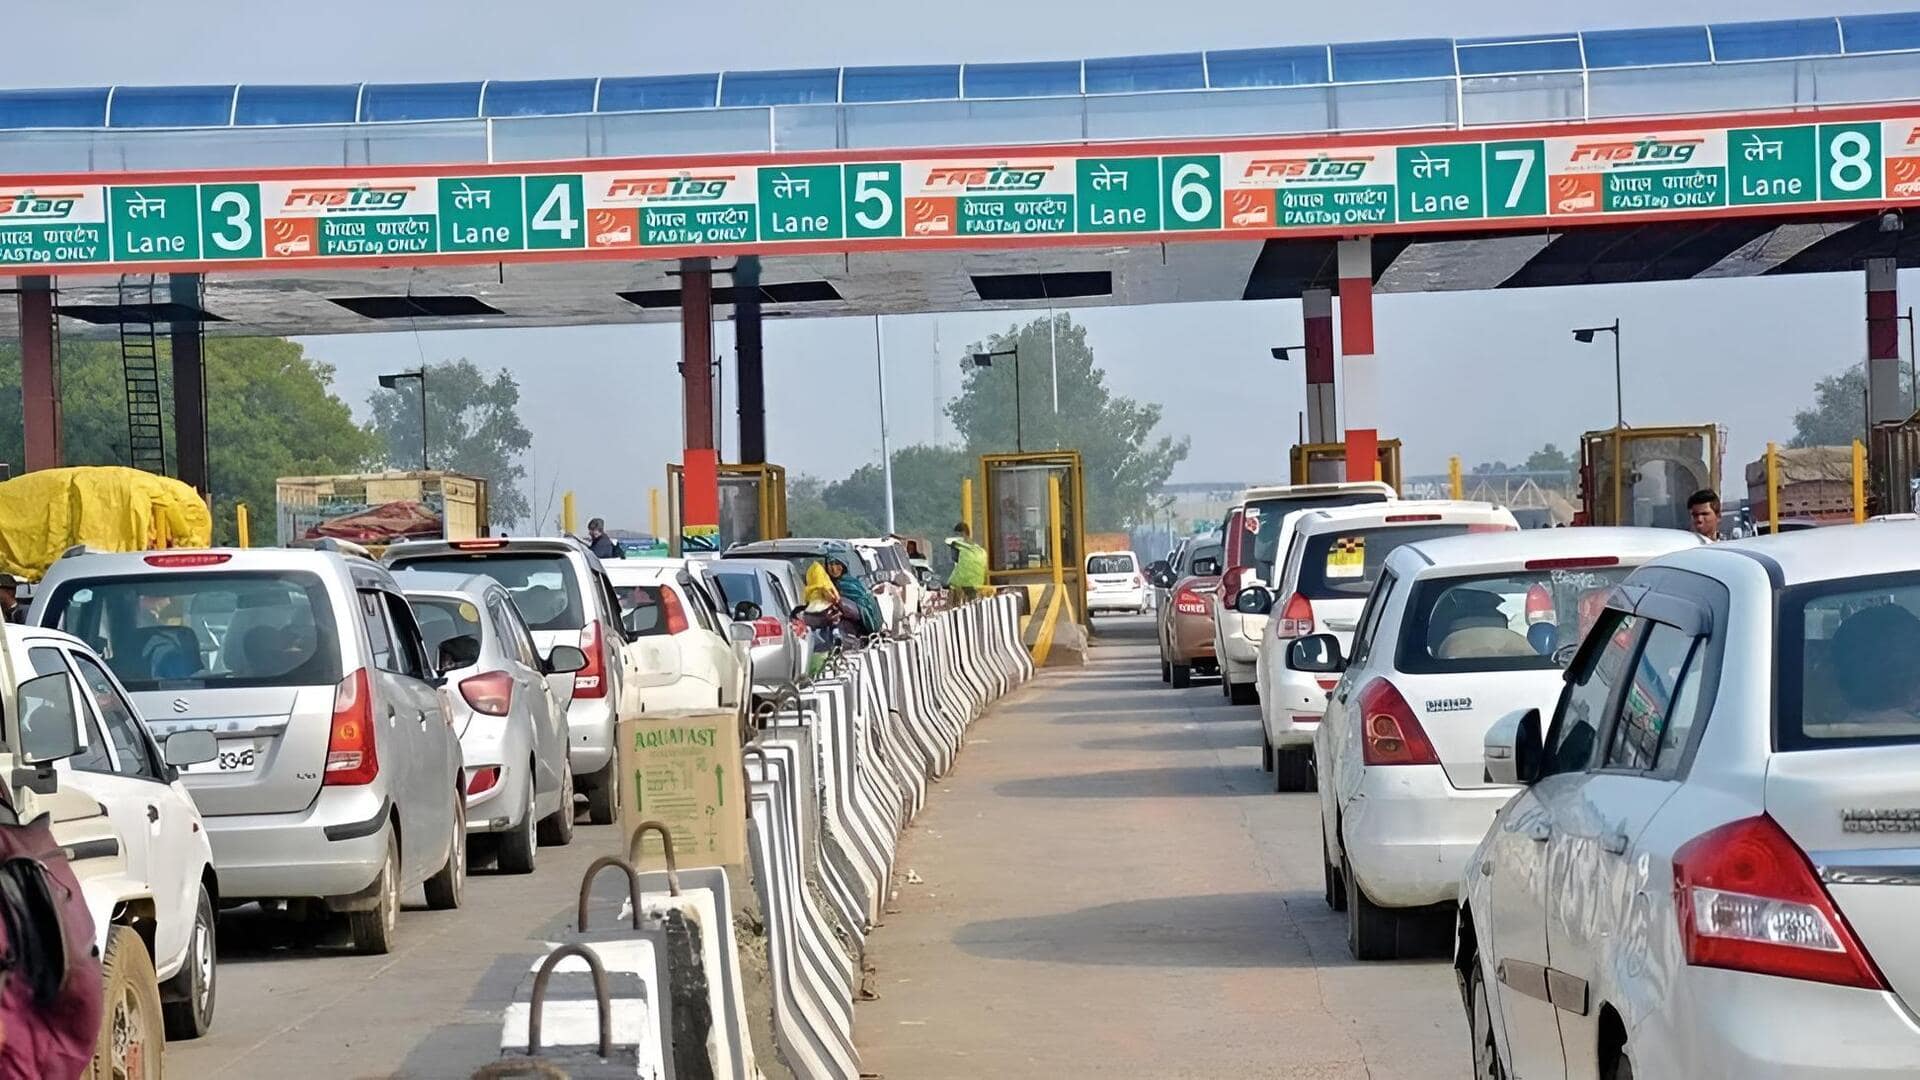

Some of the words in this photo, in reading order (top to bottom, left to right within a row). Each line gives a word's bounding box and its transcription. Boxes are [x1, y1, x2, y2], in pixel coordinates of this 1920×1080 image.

[1742, 135, 1783, 161] लेन
[1411, 151, 1451, 178] लेन
[1829, 131, 1872, 192] 8
[772, 172, 810, 199] लेन
[1090, 164, 1128, 191] लेन
[1495, 149, 1535, 208] 7
[1742, 176, 1801, 197] Lane
[126, 191, 165, 218] लेन
[451, 183, 491, 210] लेन
[854, 171, 893, 230] 5
[1171, 163, 1213, 222] 6
[1411, 192, 1470, 213] Lane
[1673, 191, 1716, 205] ONLY
[0, 193, 83, 218] STag
[531, 183, 578, 240] 4
[1091, 204, 1146, 225] Lane
[1344, 208, 1386, 221] ONLY
[211, 191, 252, 251] 3
[453, 223, 509, 244] Lane
[707, 227, 747, 240] ONLY
[772, 213, 829, 233] Lane
[1024, 218, 1065, 231] ONLY
[0, 248, 51, 261] ASTag
[55, 247, 97, 259] ONLY
[127, 232, 185, 253] Lane
[388, 238, 428, 251] ONLY
